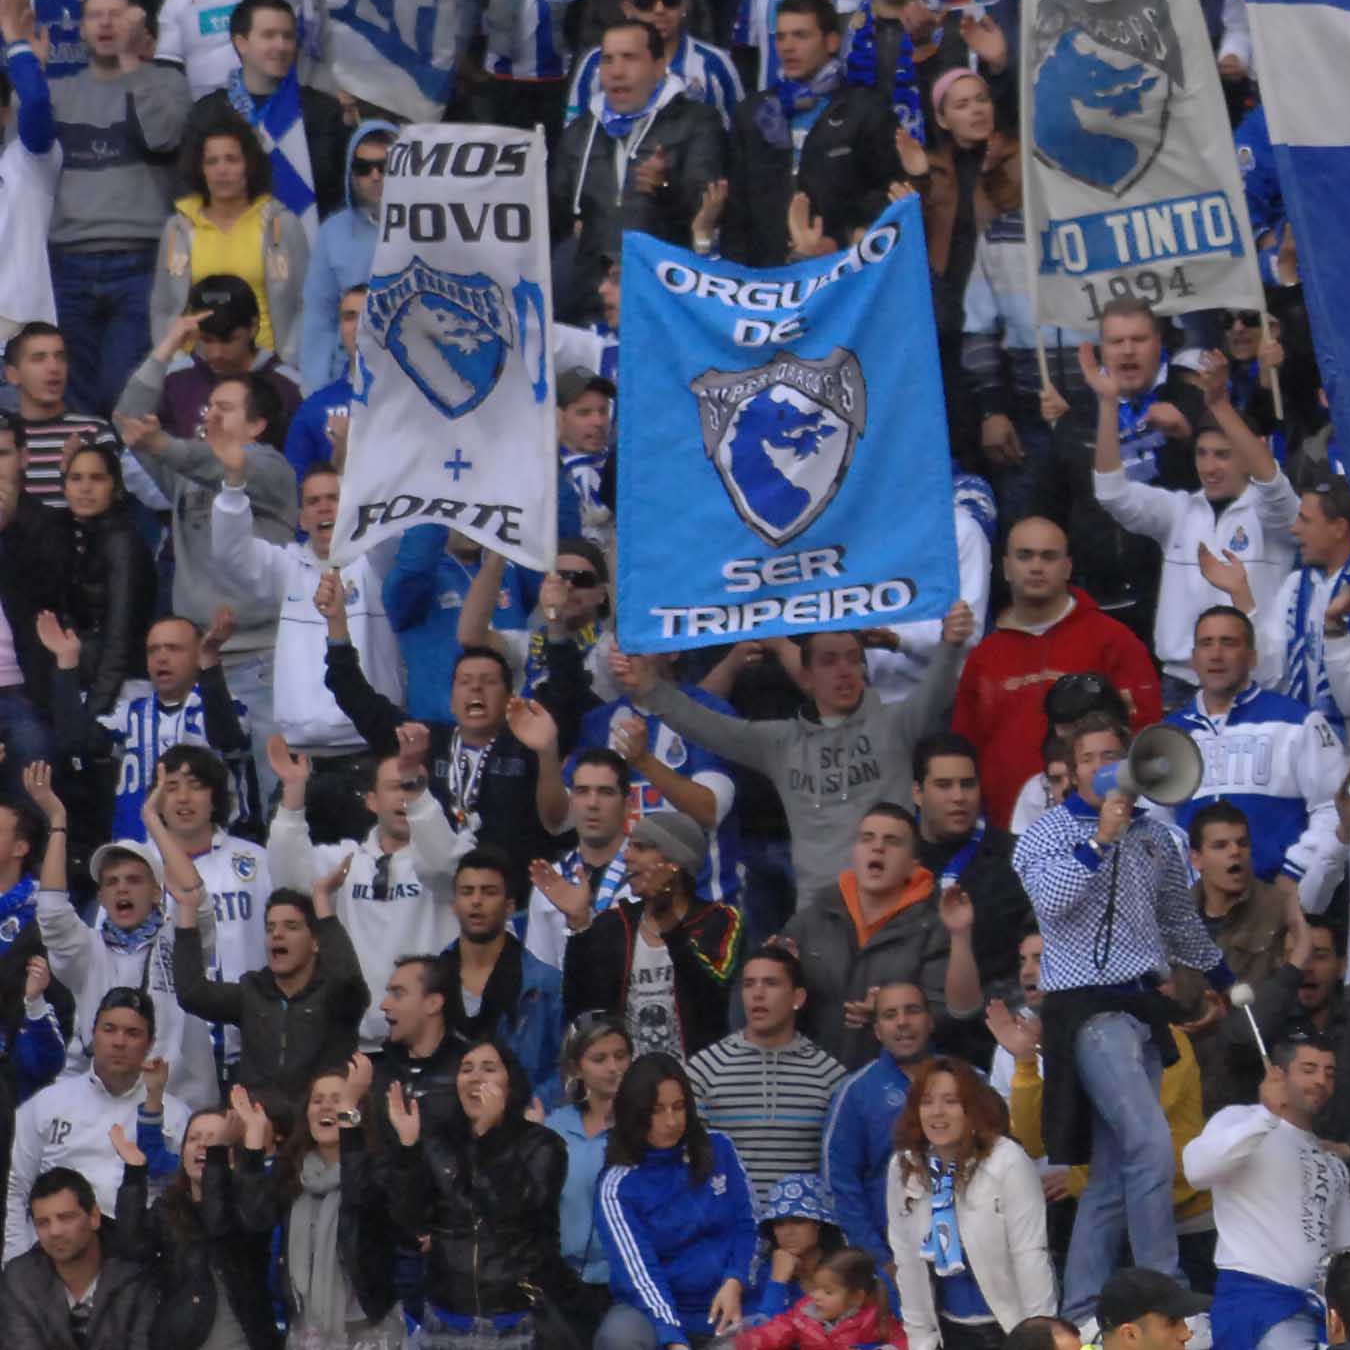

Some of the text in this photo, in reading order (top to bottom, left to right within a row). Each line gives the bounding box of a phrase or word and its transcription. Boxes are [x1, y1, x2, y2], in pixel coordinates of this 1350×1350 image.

[382, 202, 532, 243] POVO
[1106, 191, 1235, 266] TINTO
[733, 312, 807, 348] DE
[350, 494, 523, 546] FORTE
[722, 546, 844, 593] SER
[650, 579, 915, 639] TRIPEIRO
[212, 891, 252, 922] RTO
[50, 1119, 72, 1144] 12
